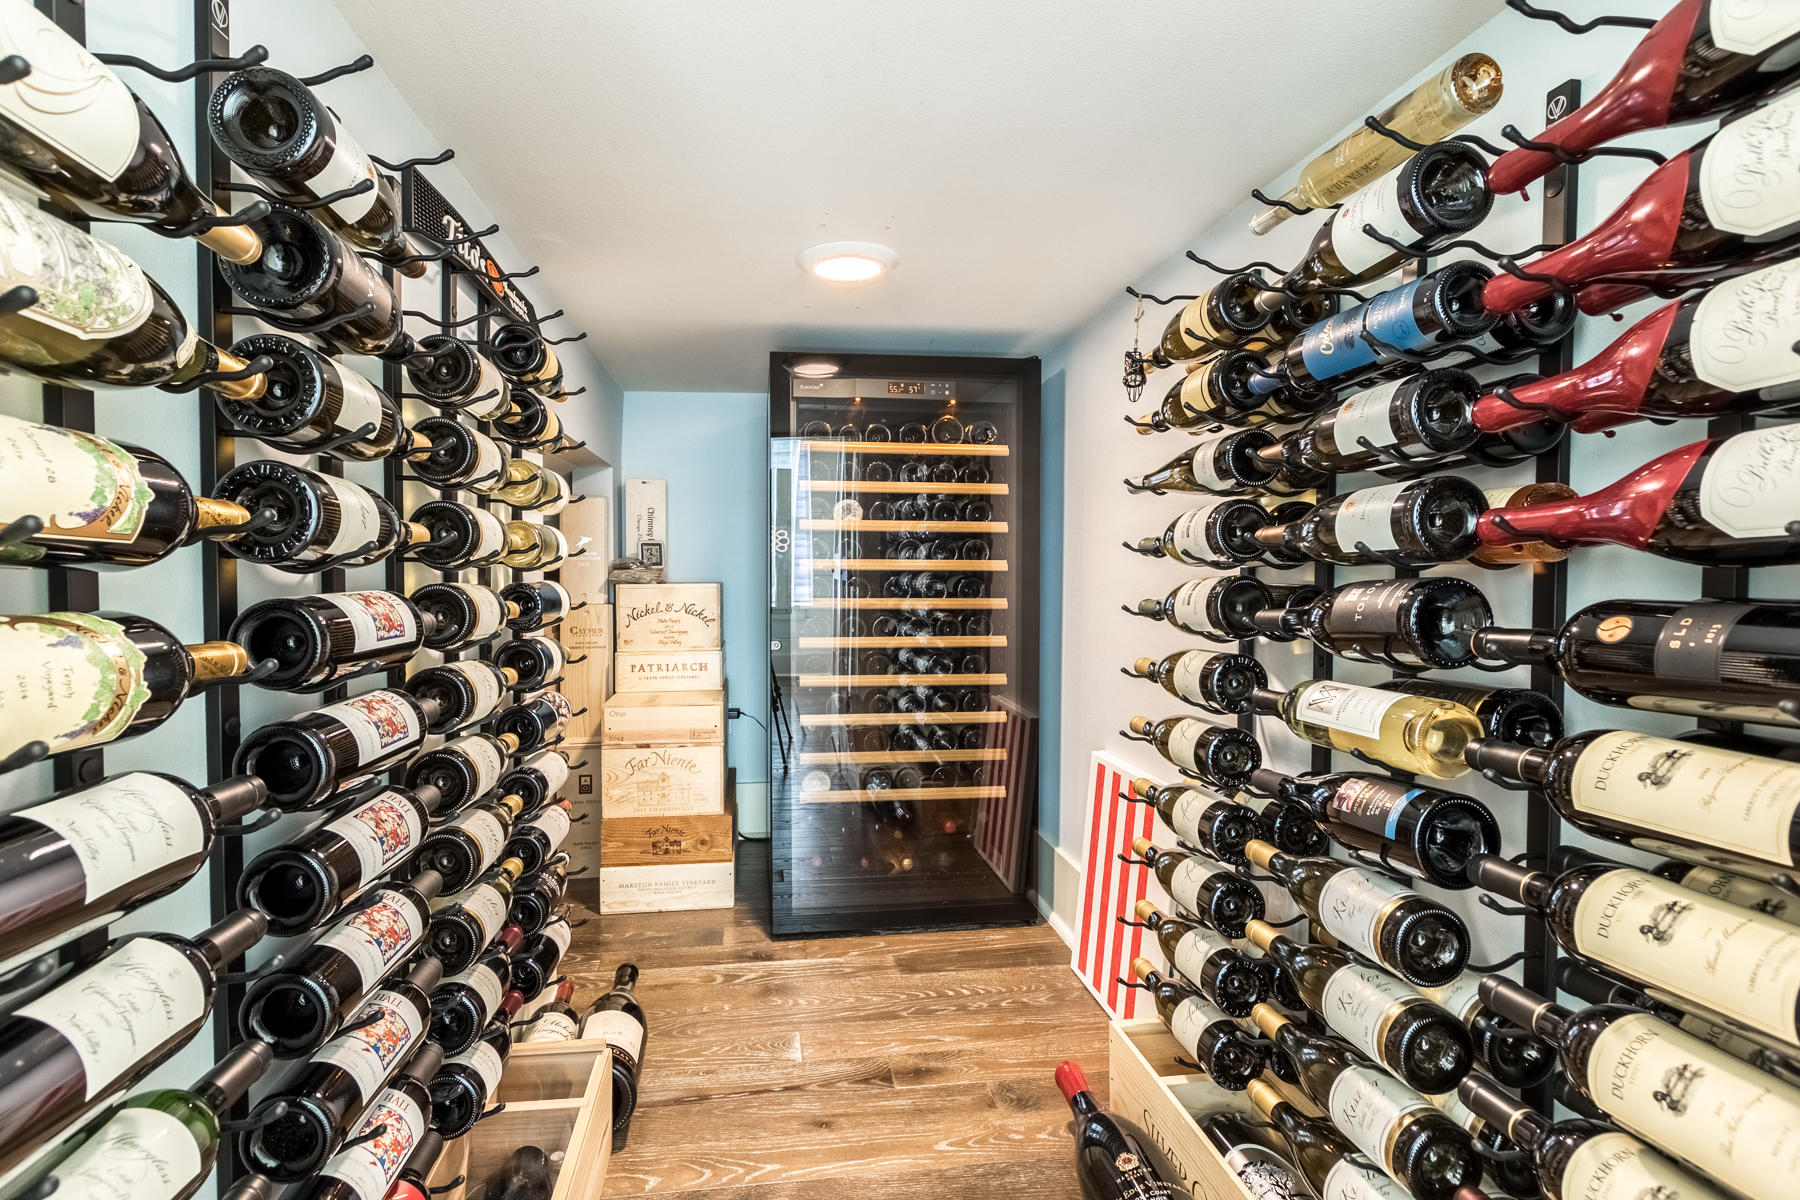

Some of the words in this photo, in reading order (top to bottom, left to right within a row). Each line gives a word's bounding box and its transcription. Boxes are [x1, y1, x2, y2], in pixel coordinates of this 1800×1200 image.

[99, 484, 131, 528] Nickel
[647, 507, 656, 538] Chimney
[625, 601, 663, 628] Nickel
[665, 603, 674, 612] &
[674, 602, 716, 628] Nickel
[569, 626, 604, 635] CAYMUS
[629, 662, 709, 673] PATRIARCH
[91, 685, 129, 735] Nickel
[625, 757, 651, 776] Far
[650, 749, 702, 775] Niente
[385, 792, 412, 816] HALL
[106, 784, 176, 855] Hourglass
[645, 827, 659, 838] Far
[660, 824, 686, 837] Niente
[654, 880, 678, 888] FAMILY
[681, 879, 717, 887] VINEYARD
[1597, 876, 1653, 939] DUCKHORN
[108, 956, 177, 1029] Hourglass
[374, 992, 403, 1010] HALL
[1611, 1028, 1660, 1101] DUCKHORN
[384, 1092, 411, 1114] HALL
[1116, 1167, 1153, 1184] HARTFORD
[1583, 1148, 1639, 1200] UCKHORN
